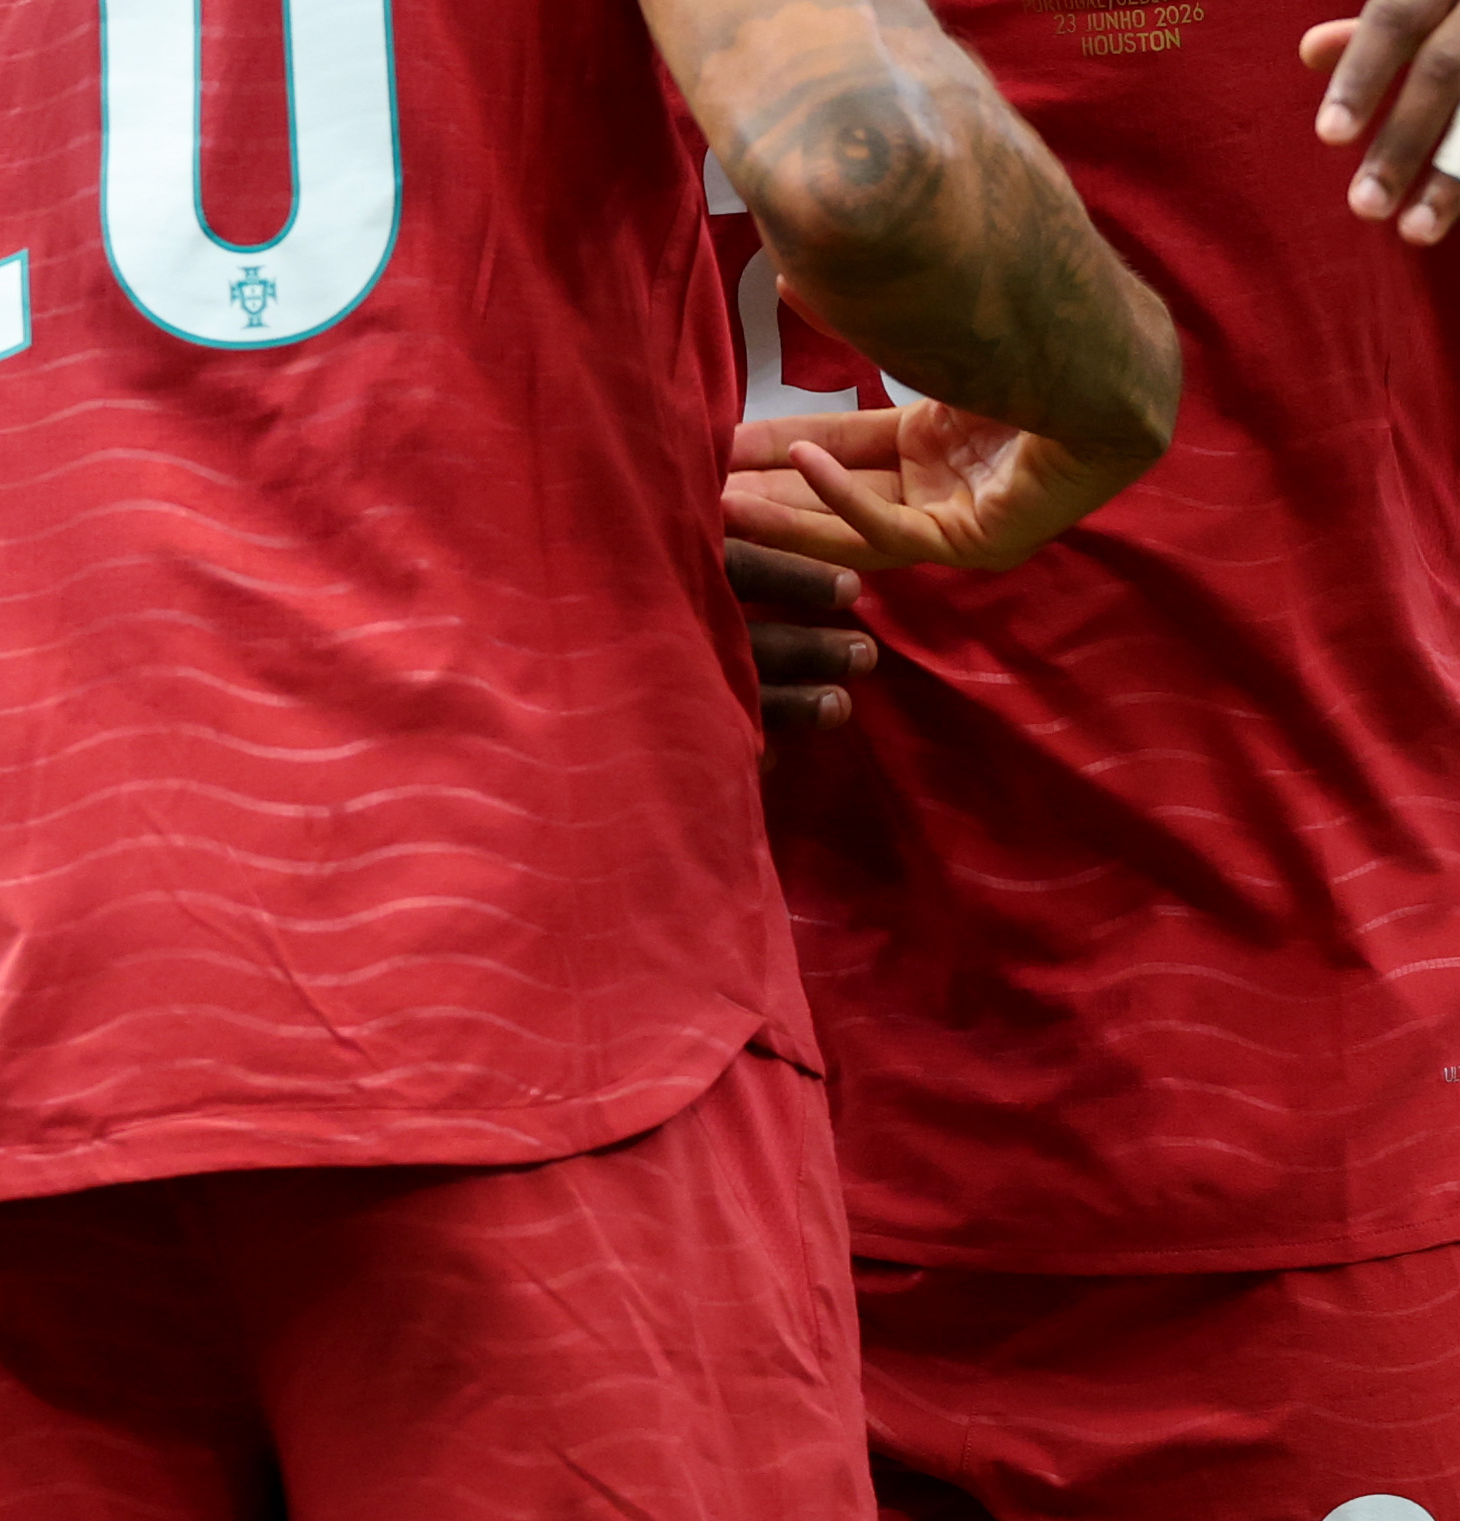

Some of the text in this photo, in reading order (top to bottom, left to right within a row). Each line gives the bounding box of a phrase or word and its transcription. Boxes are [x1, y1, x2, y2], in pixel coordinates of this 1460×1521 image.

[1053, 3, 1206, 36] 23 JUNHO 2026
[1080, 28, 1182, 57] HOUSTON
